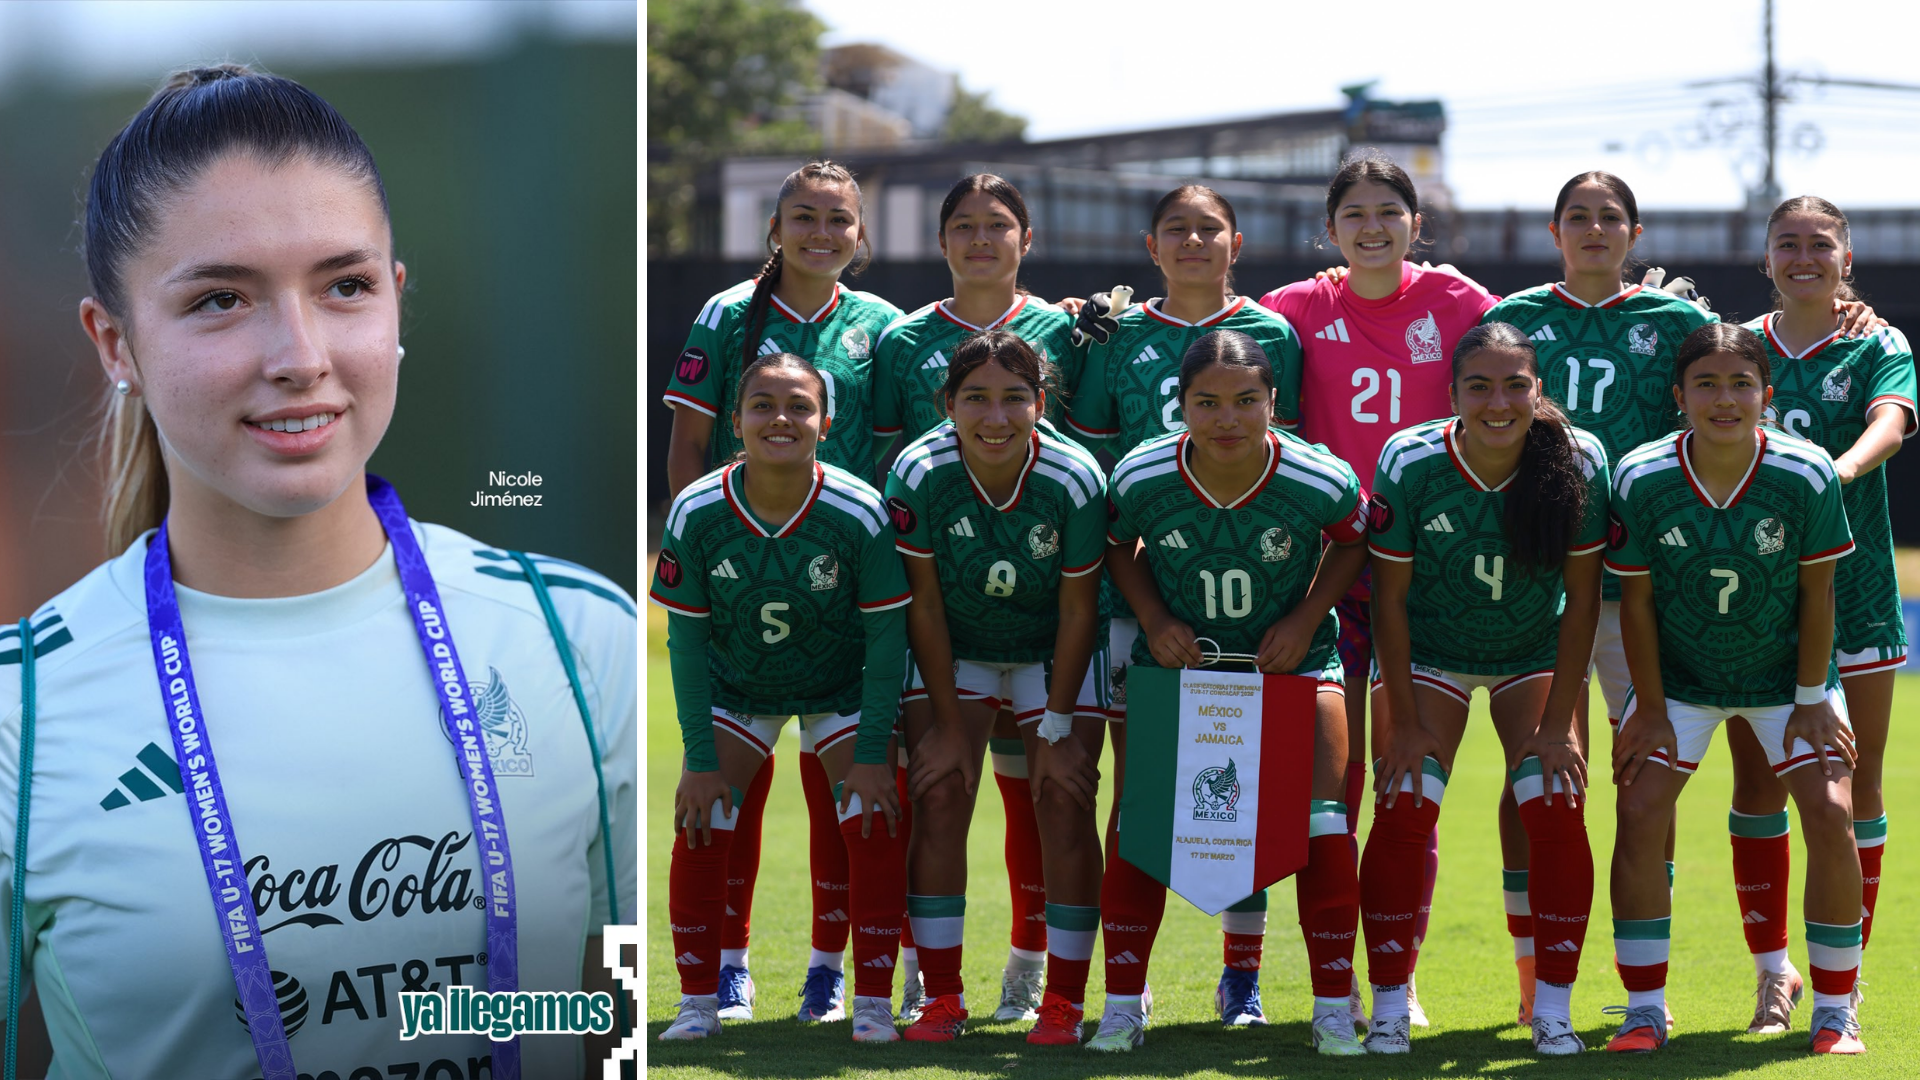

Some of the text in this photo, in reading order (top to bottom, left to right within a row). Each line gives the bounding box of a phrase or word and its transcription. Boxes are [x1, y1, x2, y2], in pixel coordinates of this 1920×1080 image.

[1413, 351, 1442, 362] MÉXICO
[1566, 356, 1616, 414] 17
[1351, 367, 1402, 424] 21
[1758, 544, 1785, 555] MÉXICO
[1262, 553, 1290, 561] MÉXICO
[984, 560, 1017, 598] 8
[1474, 554, 1504, 601] 4
[811, 581, 838, 591] MÉXICO
[1710, 568, 1739, 614] 7
[1199, 569, 1253, 620] 10
[760, 601, 790, 644] 5
[1198, 703, 1243, 718] MÉXICO
[1212, 721, 1227, 732] VS
[1194, 733, 1244, 746] JAMAICA
[418, 600, 510, 918] FIFA U-17 WOMEN'S WORLD CUP
[490, 758, 530, 774] XICO
[160, 635, 254, 955] FIFA U-17 WOMEN'S WORLD CUP
[1195, 808, 1235, 820] MÉXICO
[1212, 838, 1235, 847] COSTA
[1235, 838, 1253, 847] RICA
[1190, 851, 1236, 861] 17 DE MARZO
[348, 830, 474, 922] Cola
[816, 879, 850, 891] MÉXIC
[1736, 882, 1771, 892] ÉXICO
[1366, 912, 1413, 922] MÉXICO
[1538, 913, 1588, 923] MÉXICO
[671, 923, 707, 934] ÉXICO
[860, 926, 902, 936] MÉXICO
[1104, 922, 1148, 932] MÉXICO
[322, 954, 475, 1024] AT&T
